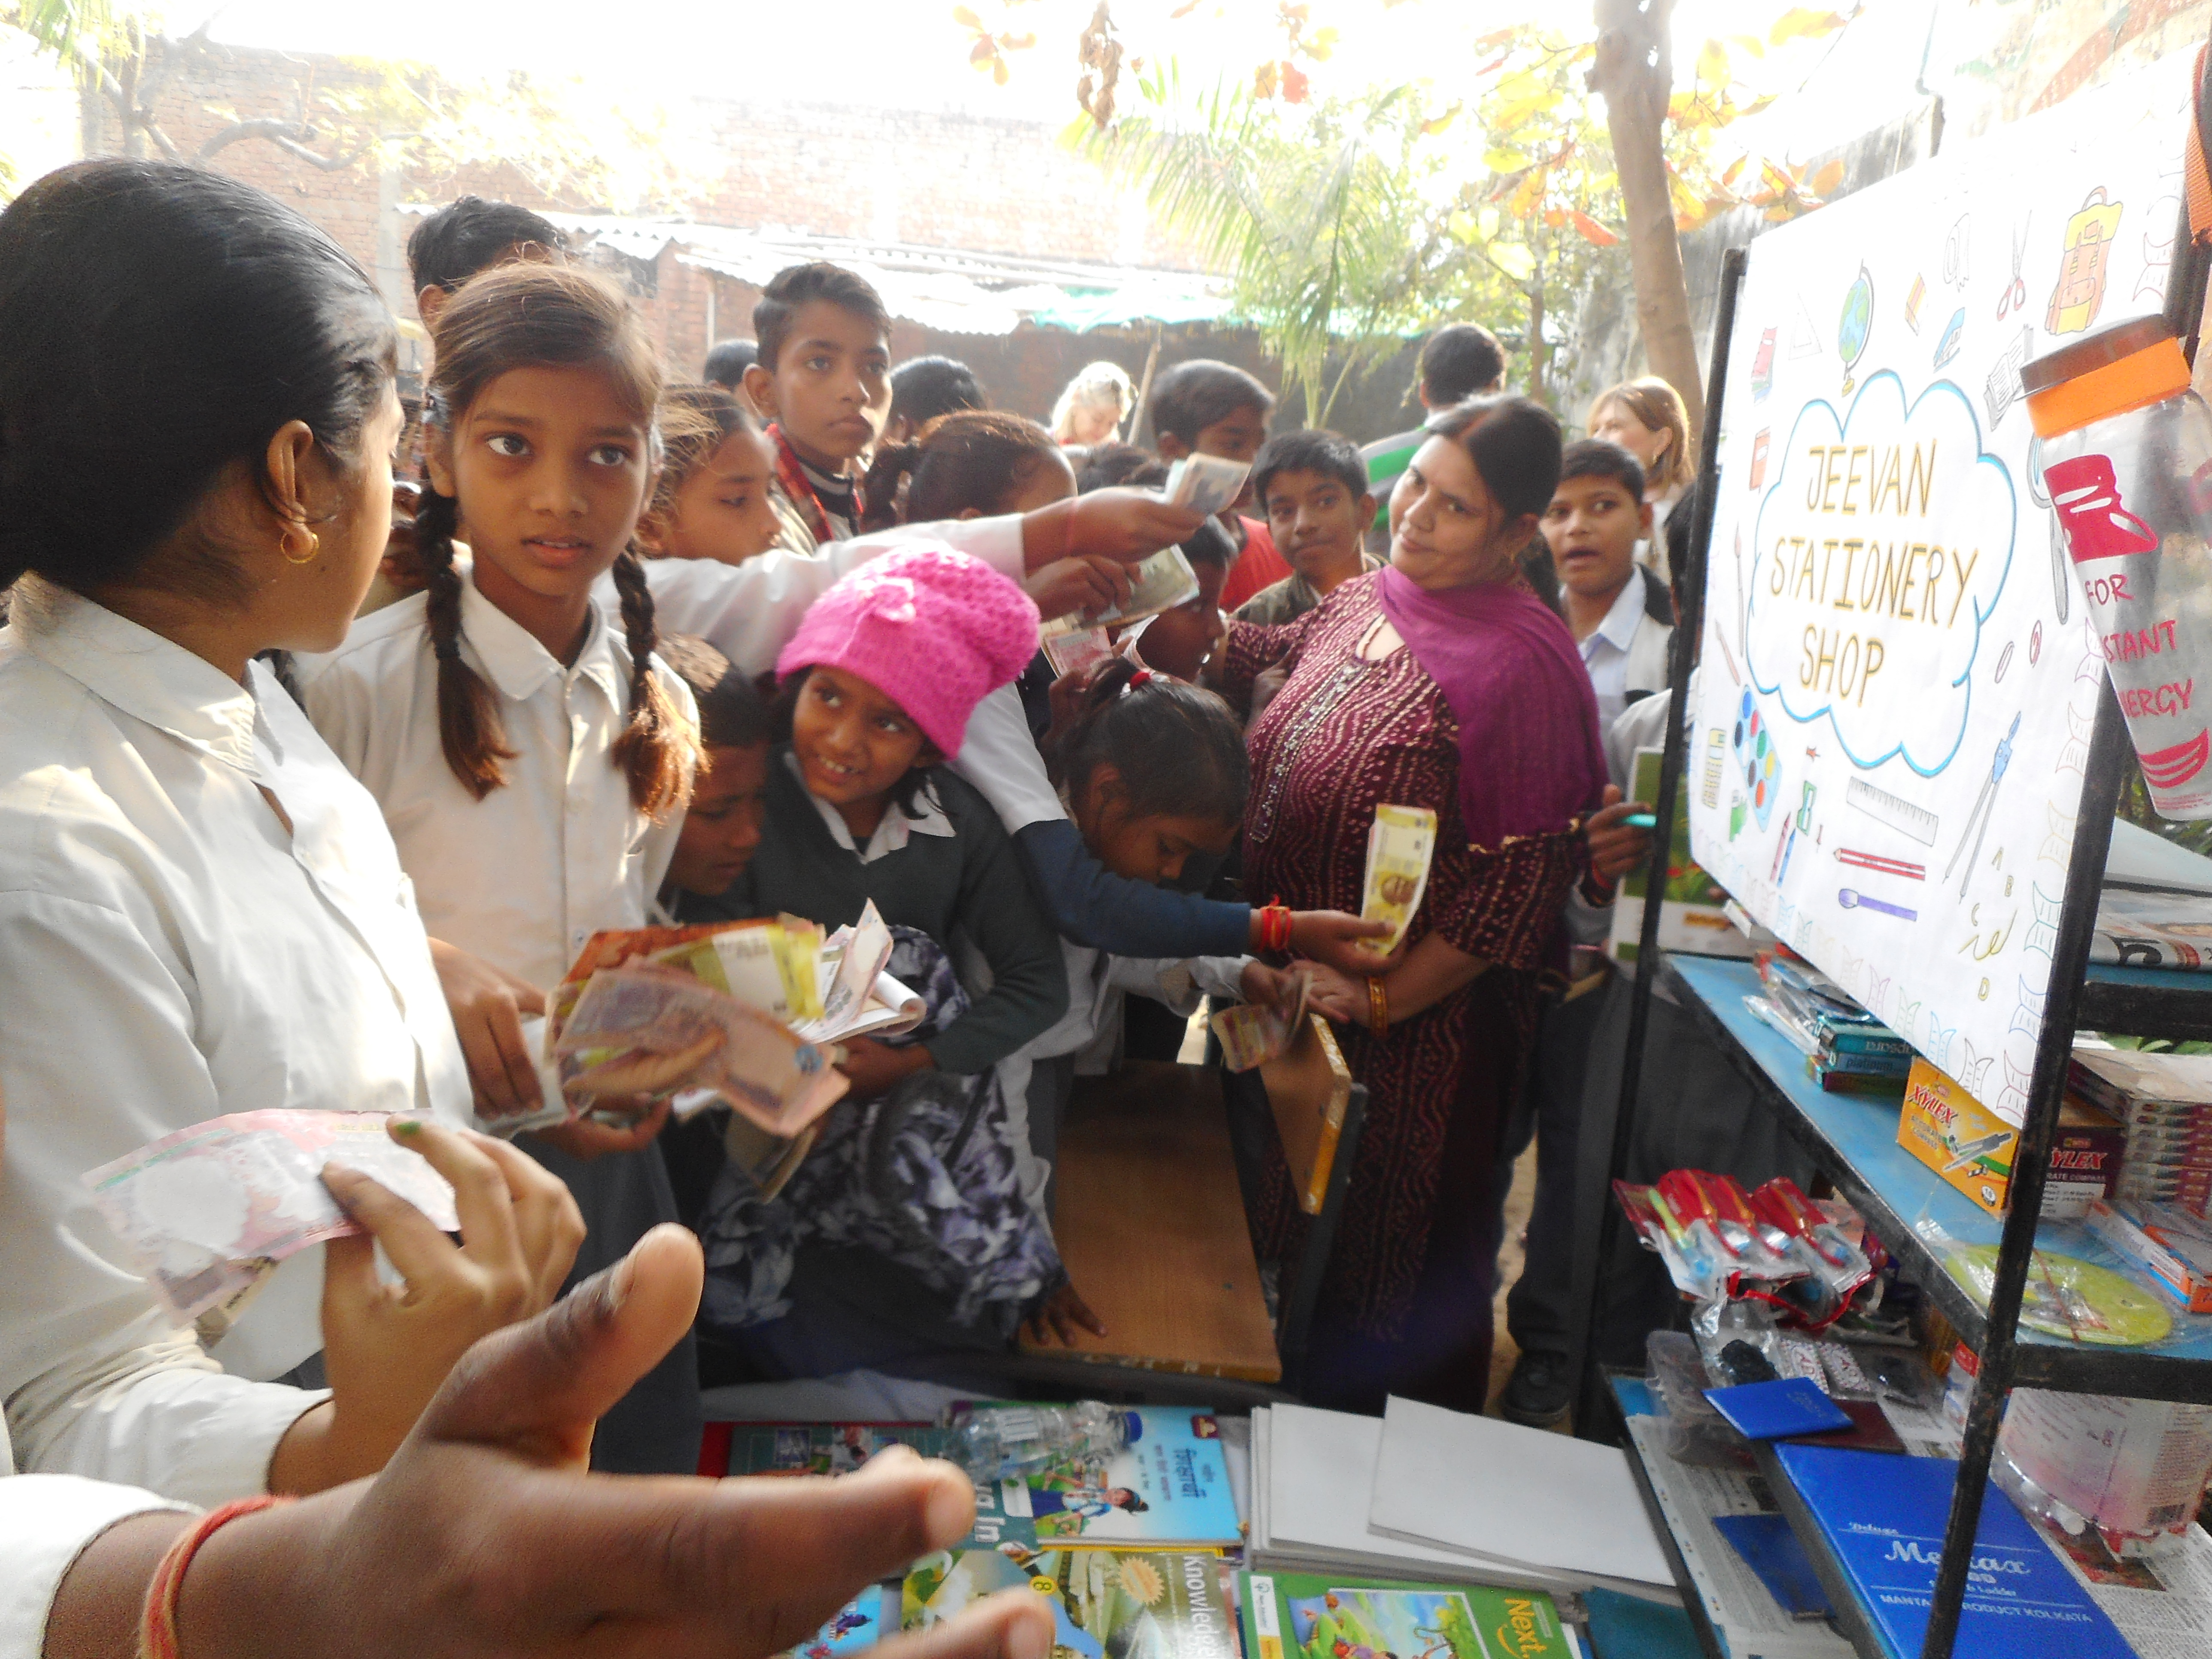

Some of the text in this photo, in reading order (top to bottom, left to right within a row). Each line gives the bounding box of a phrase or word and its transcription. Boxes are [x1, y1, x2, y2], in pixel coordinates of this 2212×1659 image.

[1807, 438, 1937, 517] JEEVAN
[1771, 536, 1978, 629] STATIONERY
[2084, 574, 2135, 610] FOR
[1800, 623, 1884, 707] SHOP
[1908, 1083, 1958, 1128] XYLEX
[2049, 1147, 2108, 1170] YLEX
